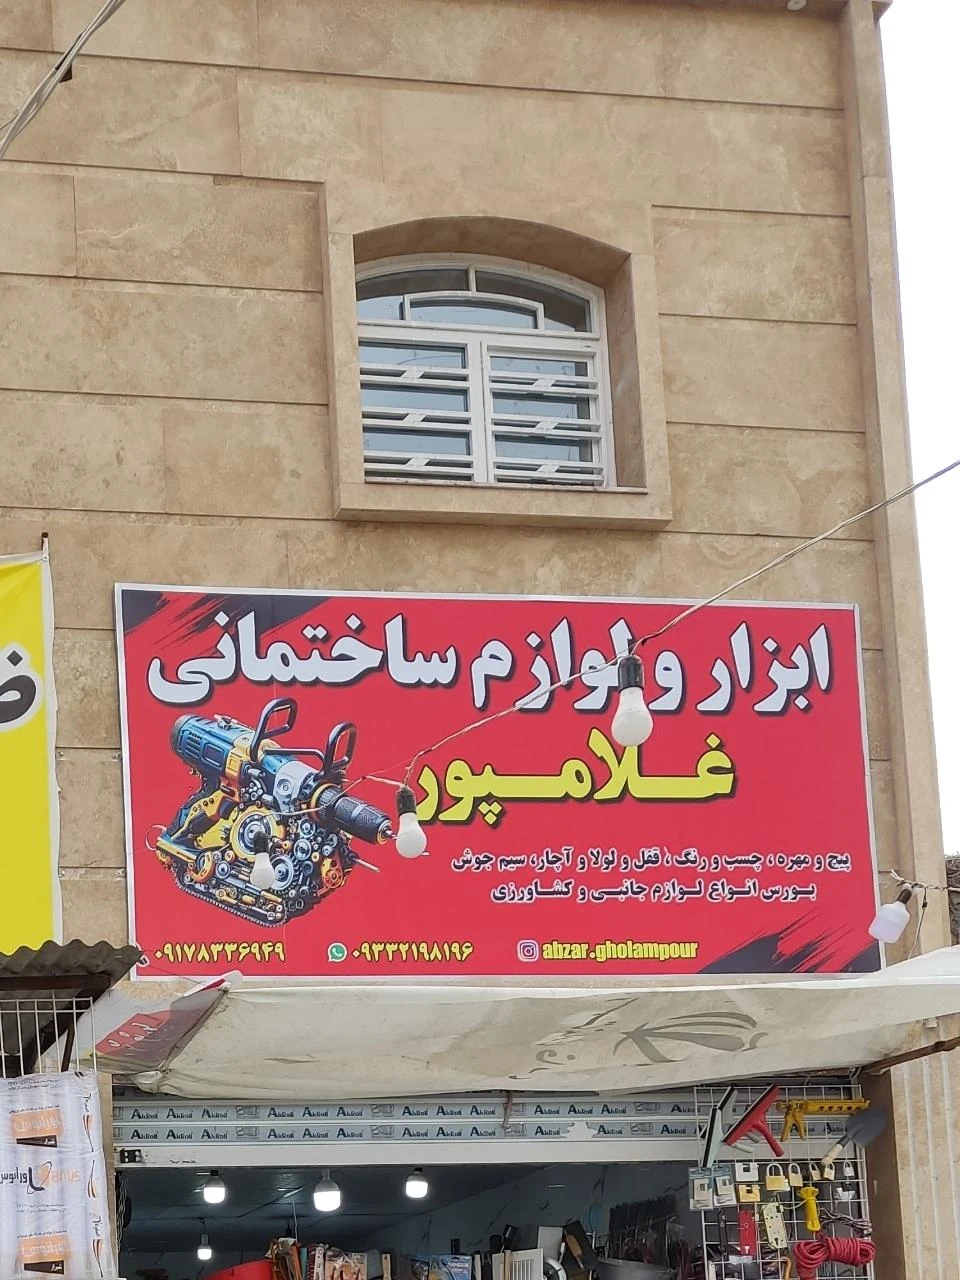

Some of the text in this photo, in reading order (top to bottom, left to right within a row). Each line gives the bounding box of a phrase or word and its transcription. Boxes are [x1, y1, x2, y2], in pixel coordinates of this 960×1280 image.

[147, 610, 831, 712] ابزار و لوازم ساختمانی
[413, 728, 736, 826] غلامپور
[542, 939, 699, 963] abzar.gholampour
